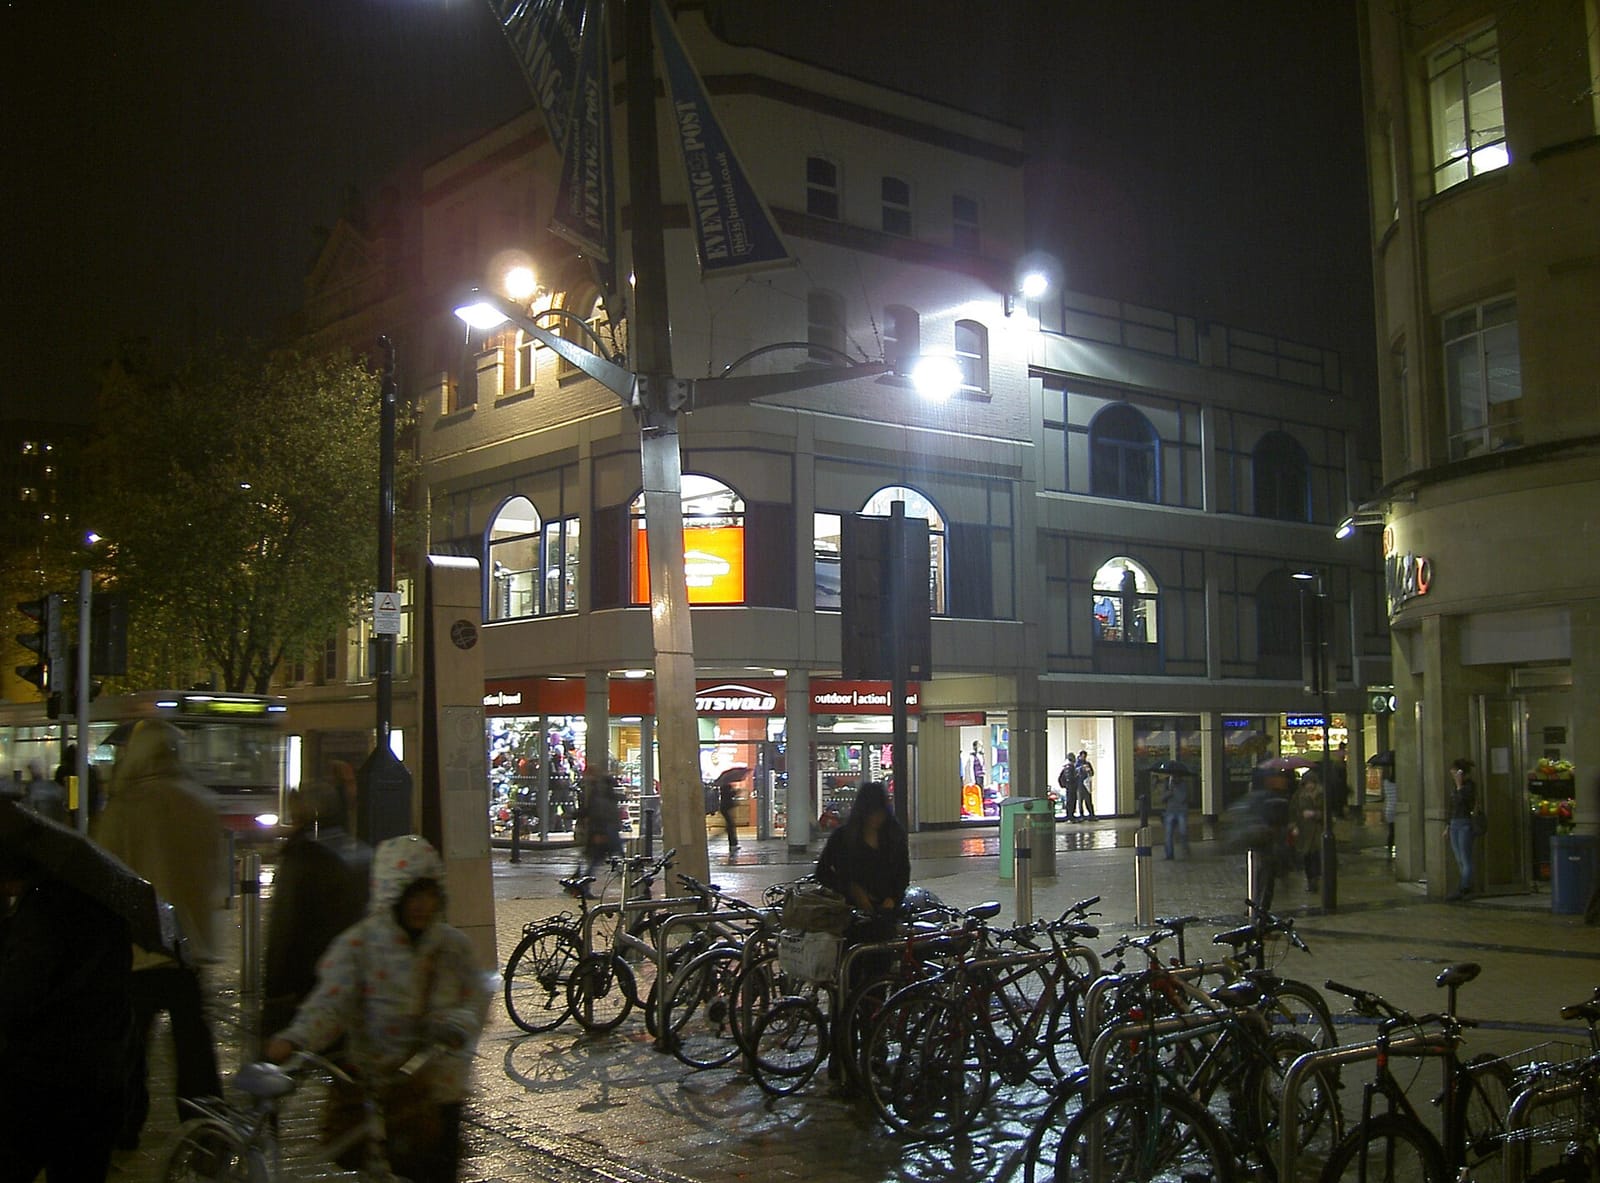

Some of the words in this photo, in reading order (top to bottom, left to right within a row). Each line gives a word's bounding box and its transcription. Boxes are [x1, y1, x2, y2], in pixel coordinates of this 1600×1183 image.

[675, 100, 705, 150] POST
[715, 151, 739, 218] bristol.co.uk
[692, 170, 728, 260] EVENING
[814, 692, 852, 704] outdoor
[858, 693, 886, 704] action
